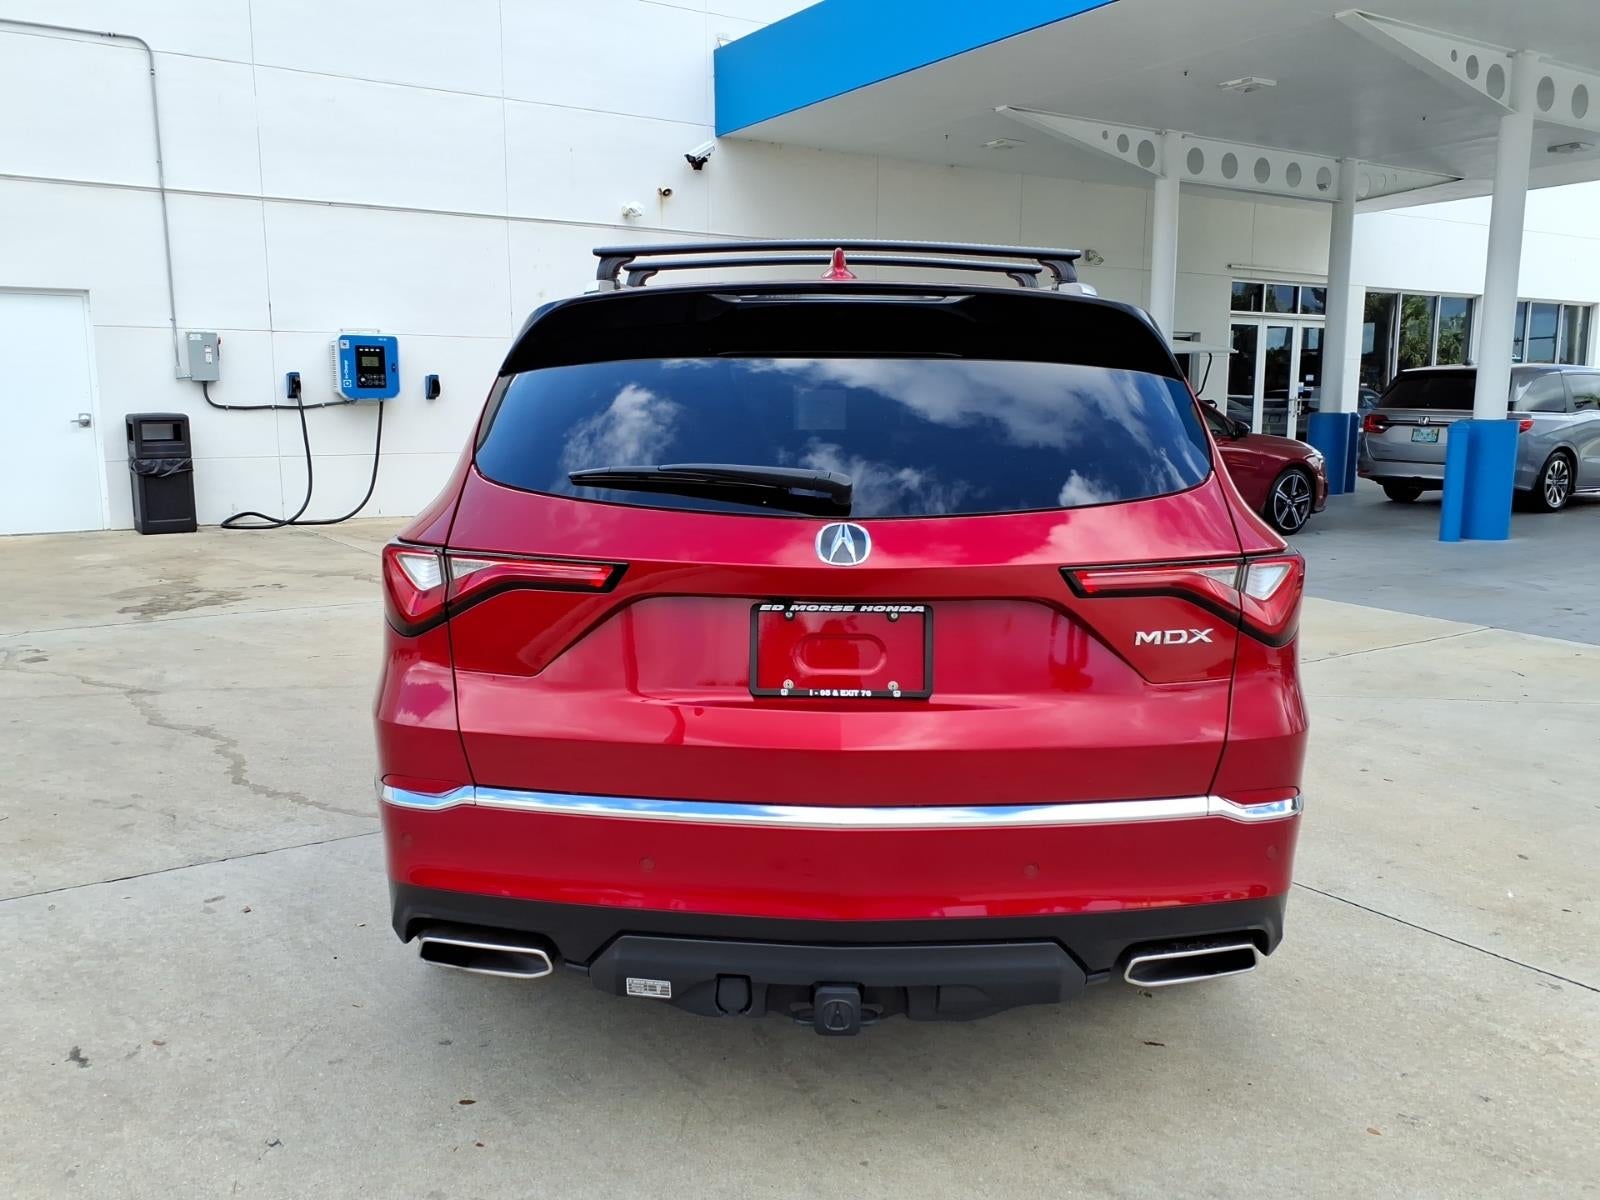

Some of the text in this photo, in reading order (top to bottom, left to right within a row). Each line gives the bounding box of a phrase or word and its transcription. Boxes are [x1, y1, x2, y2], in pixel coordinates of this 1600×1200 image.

[790, 604, 856, 612] MORSE
[1134, 628, 1214, 646] MDX
[839, 689, 860, 697] EXIT
